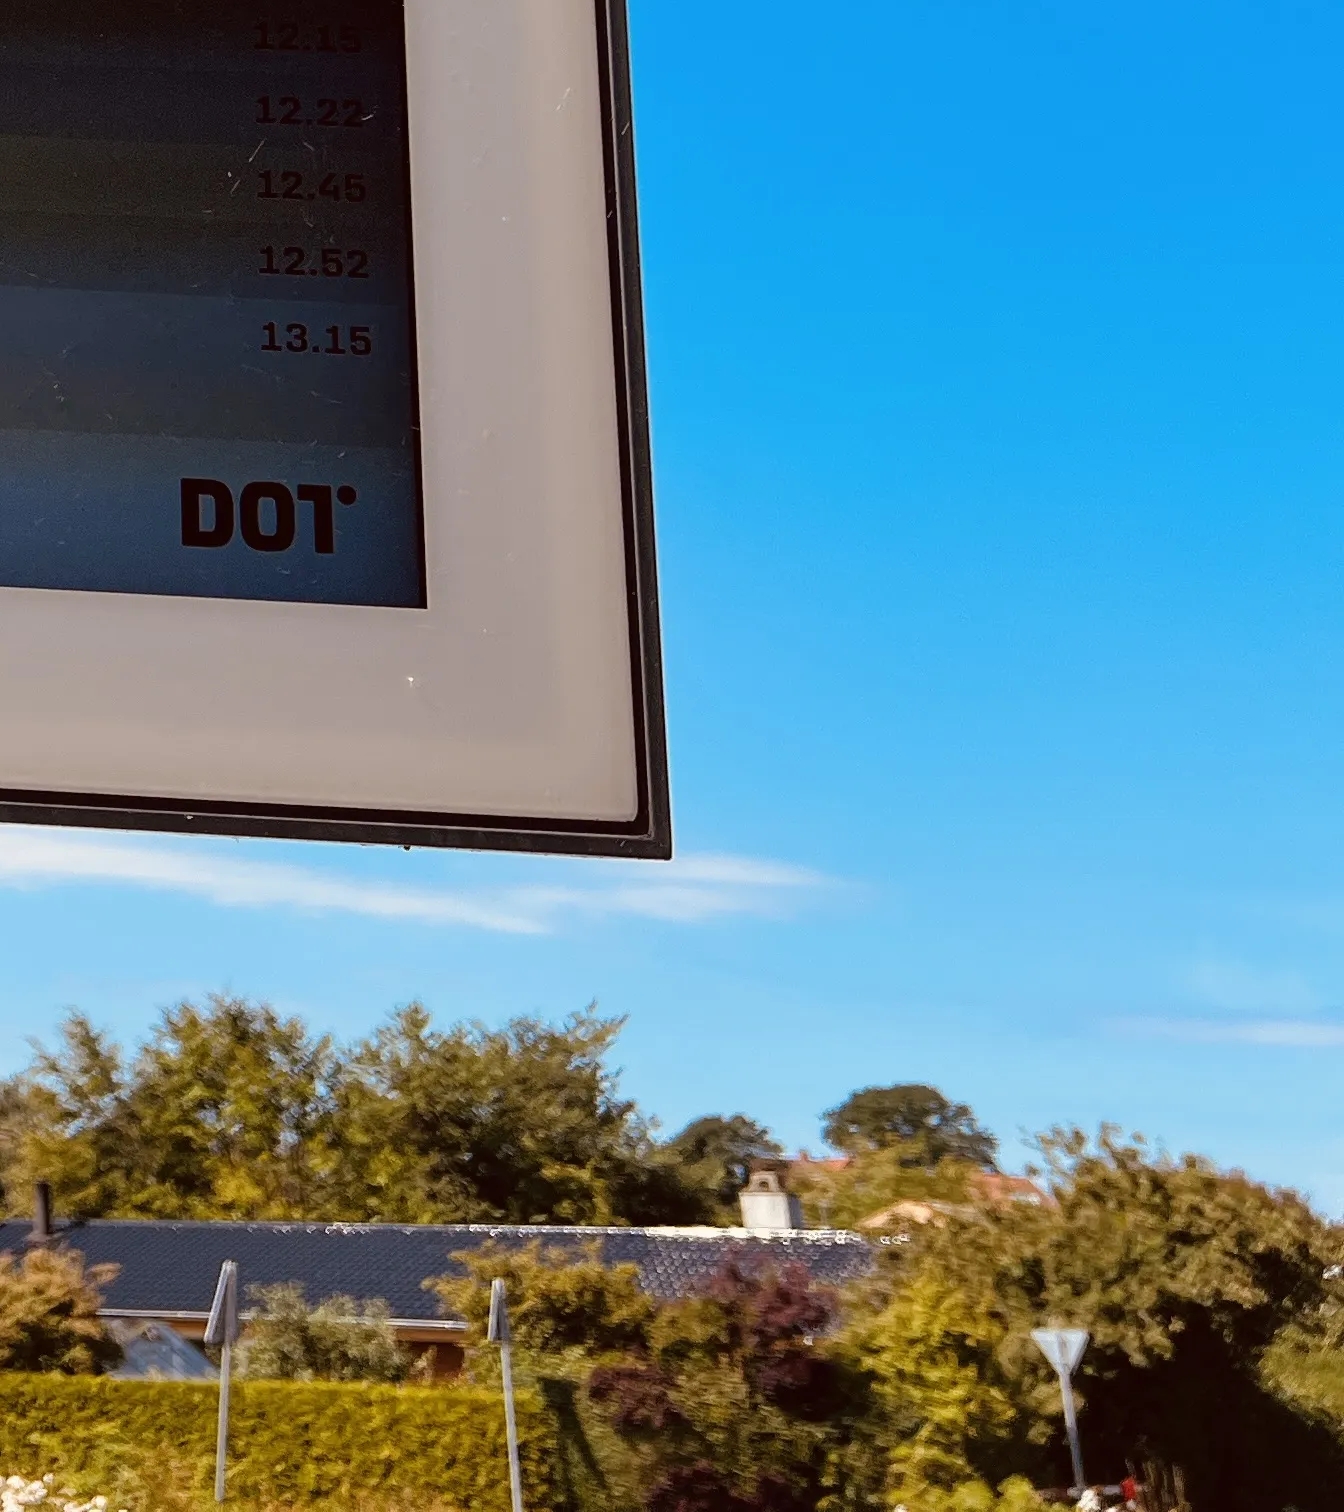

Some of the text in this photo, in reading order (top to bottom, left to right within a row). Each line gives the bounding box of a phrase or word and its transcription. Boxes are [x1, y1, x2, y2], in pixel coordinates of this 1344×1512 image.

[255, 96, 364, 128] 12.22
[257, 170, 366, 202] 12.45
[258, 246, 369, 279] 12.52
[260, 321, 372, 356] 13.15
[179, 477, 336, 554] DOT
